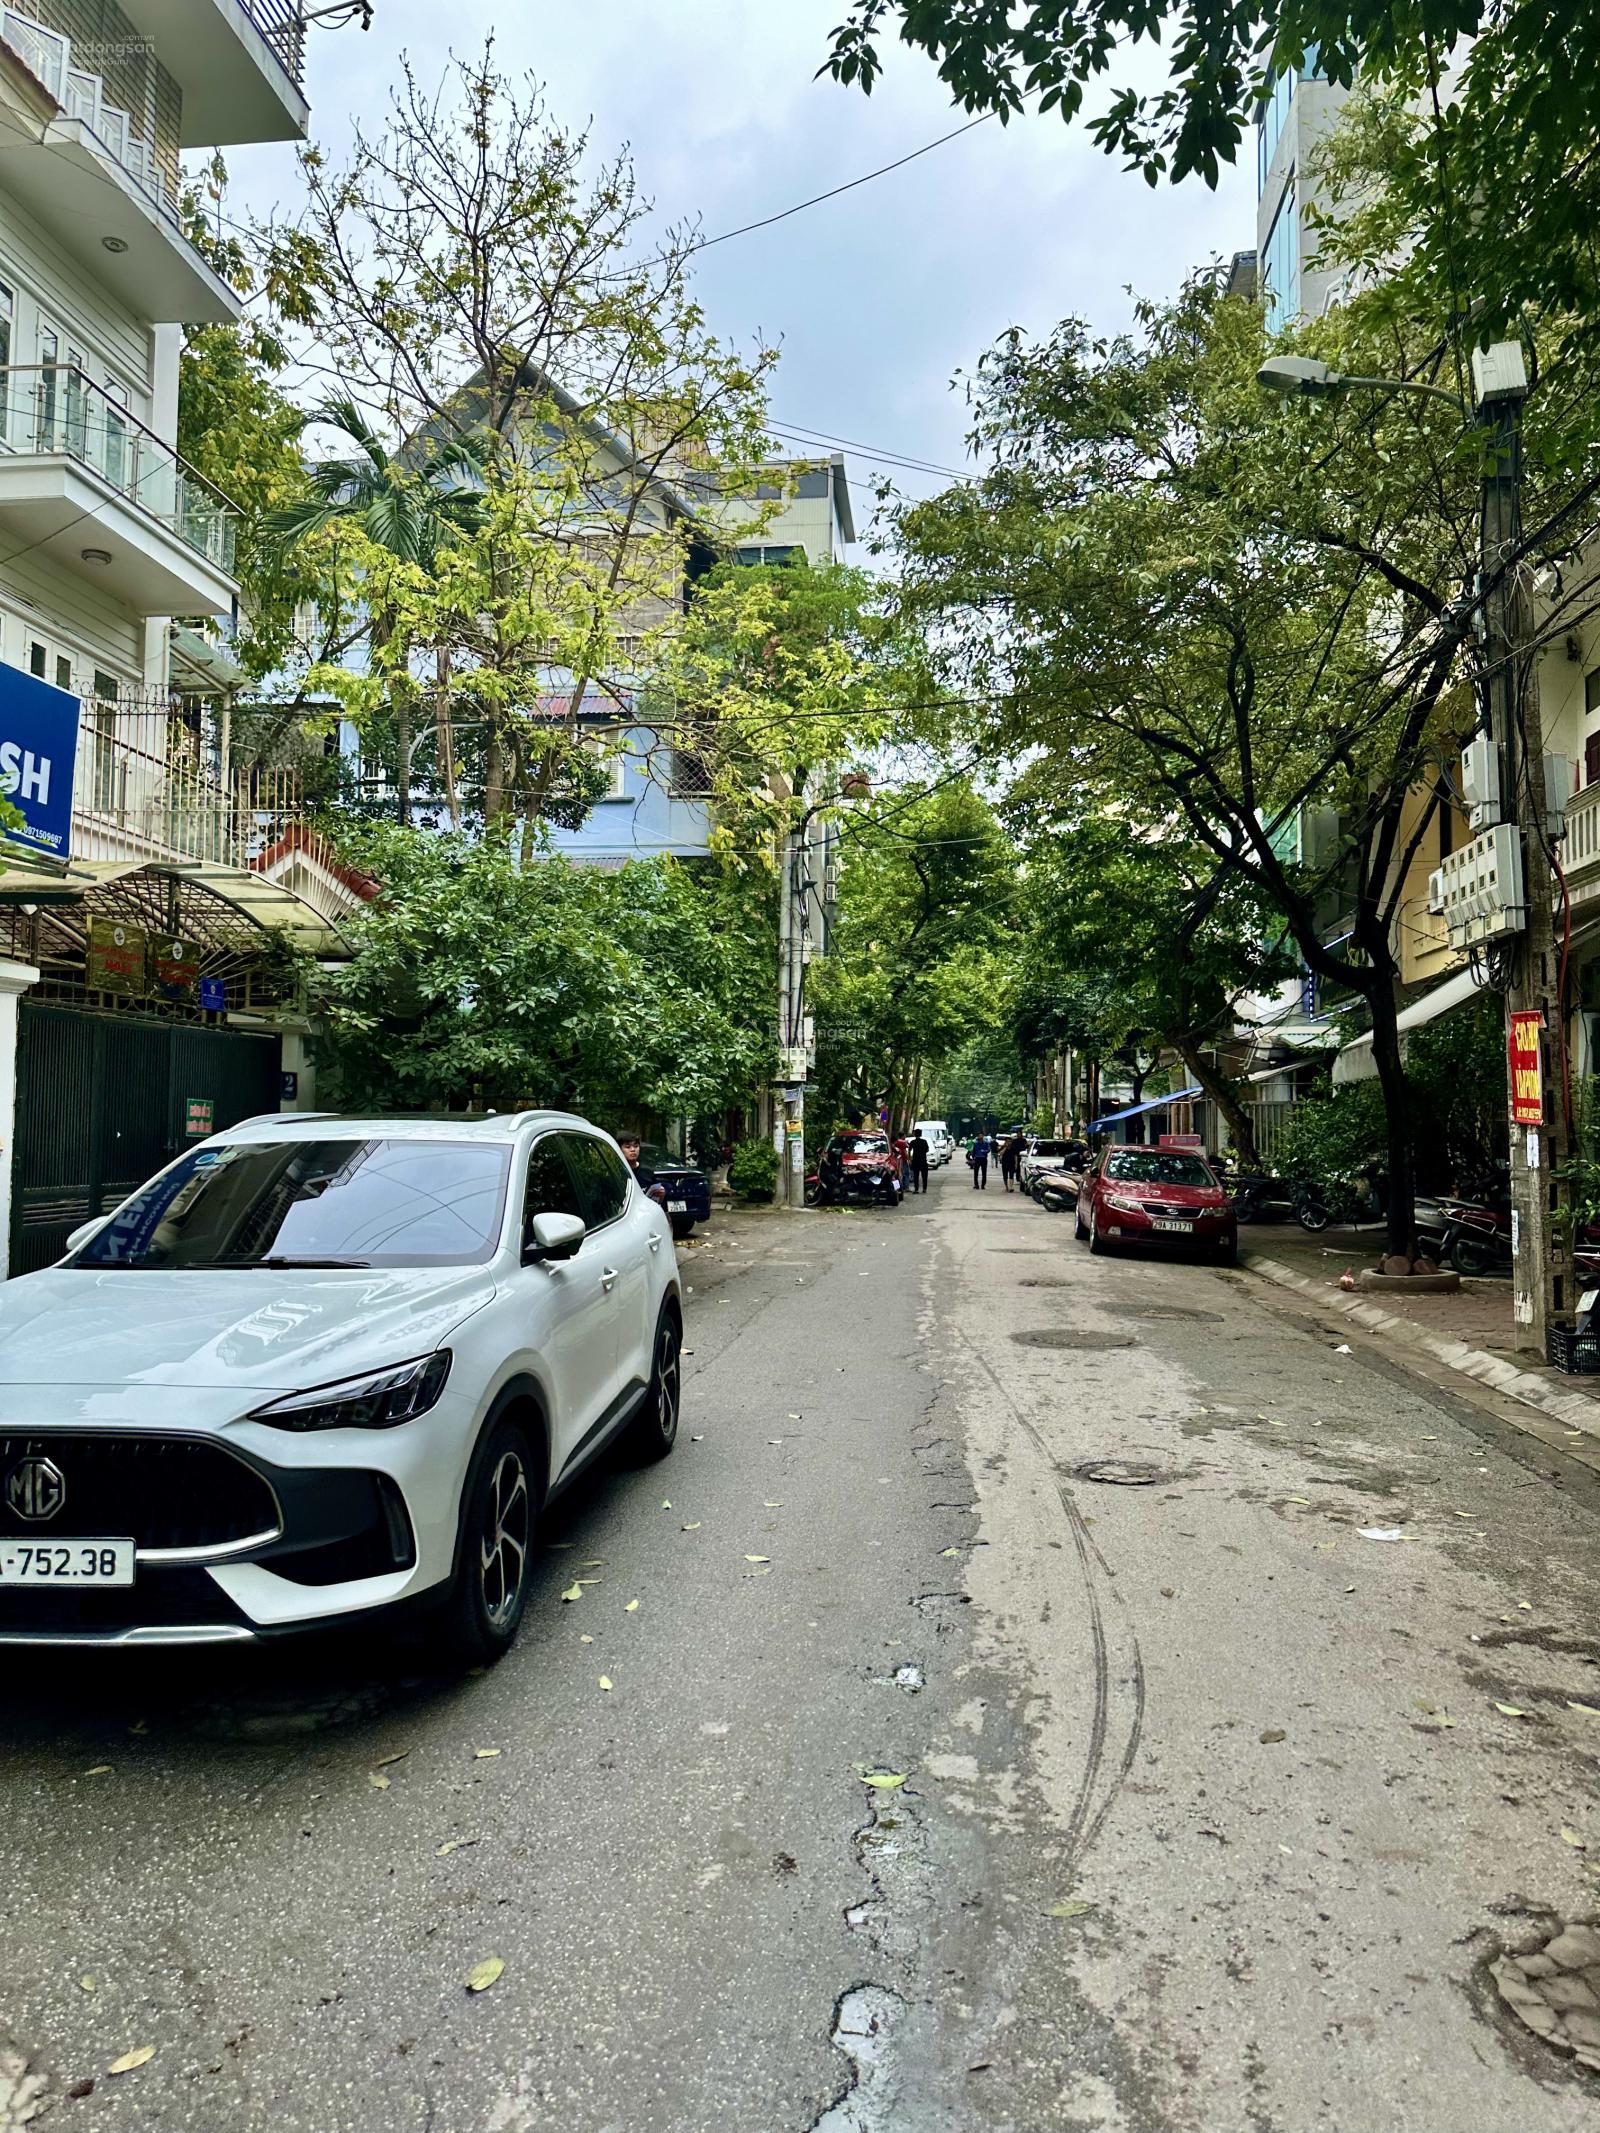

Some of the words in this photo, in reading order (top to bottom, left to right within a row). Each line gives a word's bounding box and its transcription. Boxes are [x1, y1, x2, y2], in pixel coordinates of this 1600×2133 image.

[284, 1074, 295, 1092] 2
[10, 1463, 59, 1515] MG
[0, 1548, 117, 1576] -752.38
